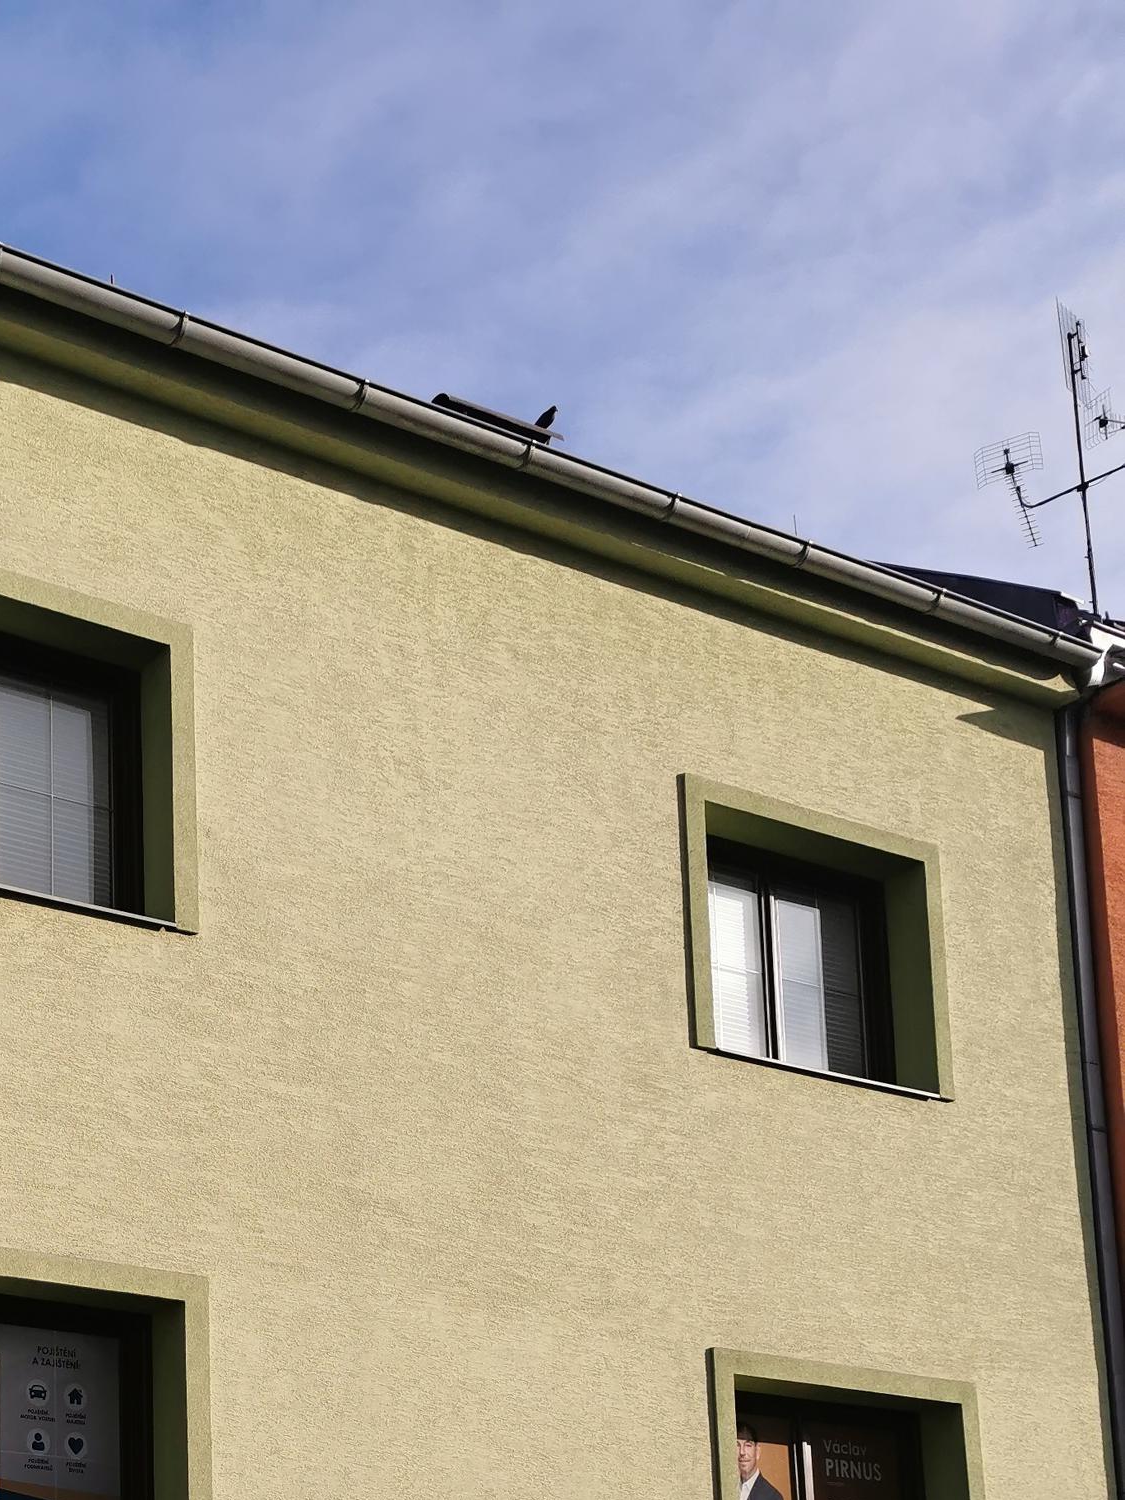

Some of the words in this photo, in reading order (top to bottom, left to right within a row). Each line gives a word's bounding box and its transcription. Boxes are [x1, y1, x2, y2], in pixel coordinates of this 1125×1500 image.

[37, 1345, 77, 1358] POJIŠTĚNÍ
[823, 1439, 867, 1456] Václav
[825, 1458, 883, 1481] PIRNUS
